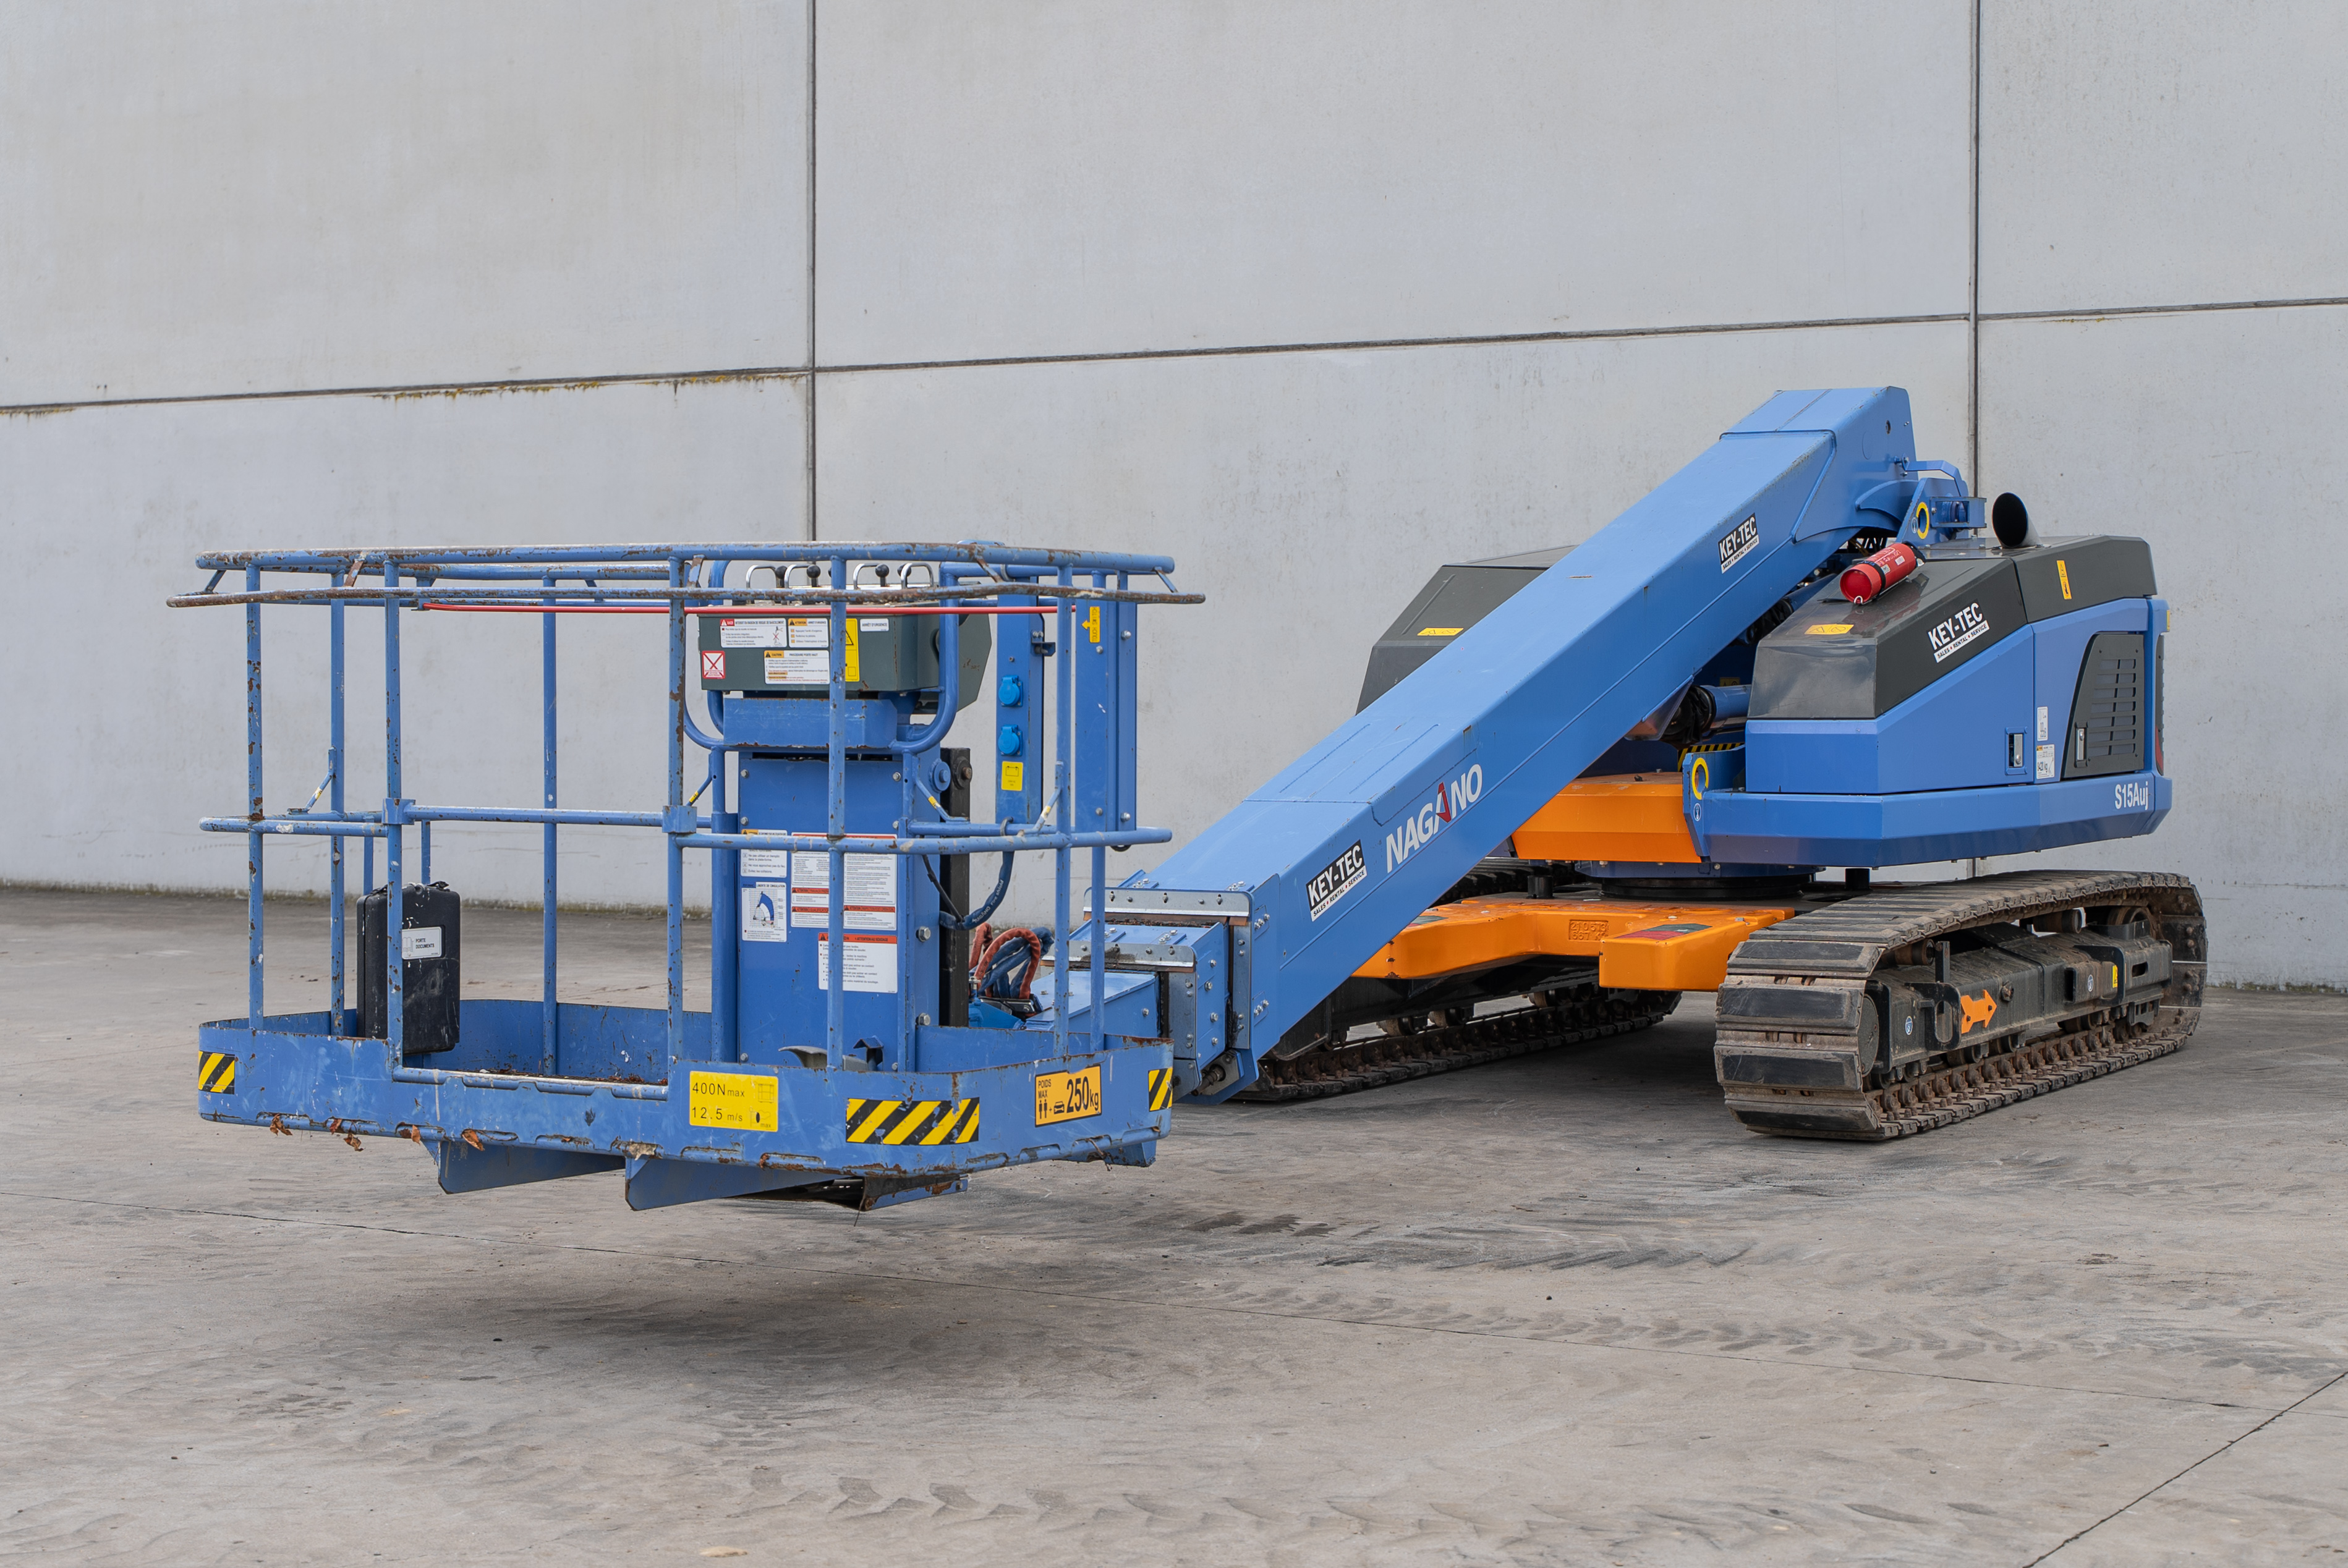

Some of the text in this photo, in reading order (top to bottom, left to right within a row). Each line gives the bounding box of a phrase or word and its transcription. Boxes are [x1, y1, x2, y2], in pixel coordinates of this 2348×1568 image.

[1719, 517, 1756, 562] KEY-TEC
[1722, 538, 1758, 570] SALES RENTAL SERVICE
[1928, 602, 1983, 650] KEY-TEC
[1937, 623, 1987, 659] SALES RENTAL SERVICE
[2114, 781, 2148, 811] S15Auj
[1386, 763, 1482, 874] NAGANO
[1308, 845, 1363, 907] KEY-TEC
[1313, 869, 1365, 917] SALES RENTAL SERVICE
[692, 1082, 725, 1095] 400N
[1038, 1079, 1052, 1089] POIDS
[1038, 1089, 1048, 1099] MAX
[692, 1107, 743, 1122] 12.5 m/s
